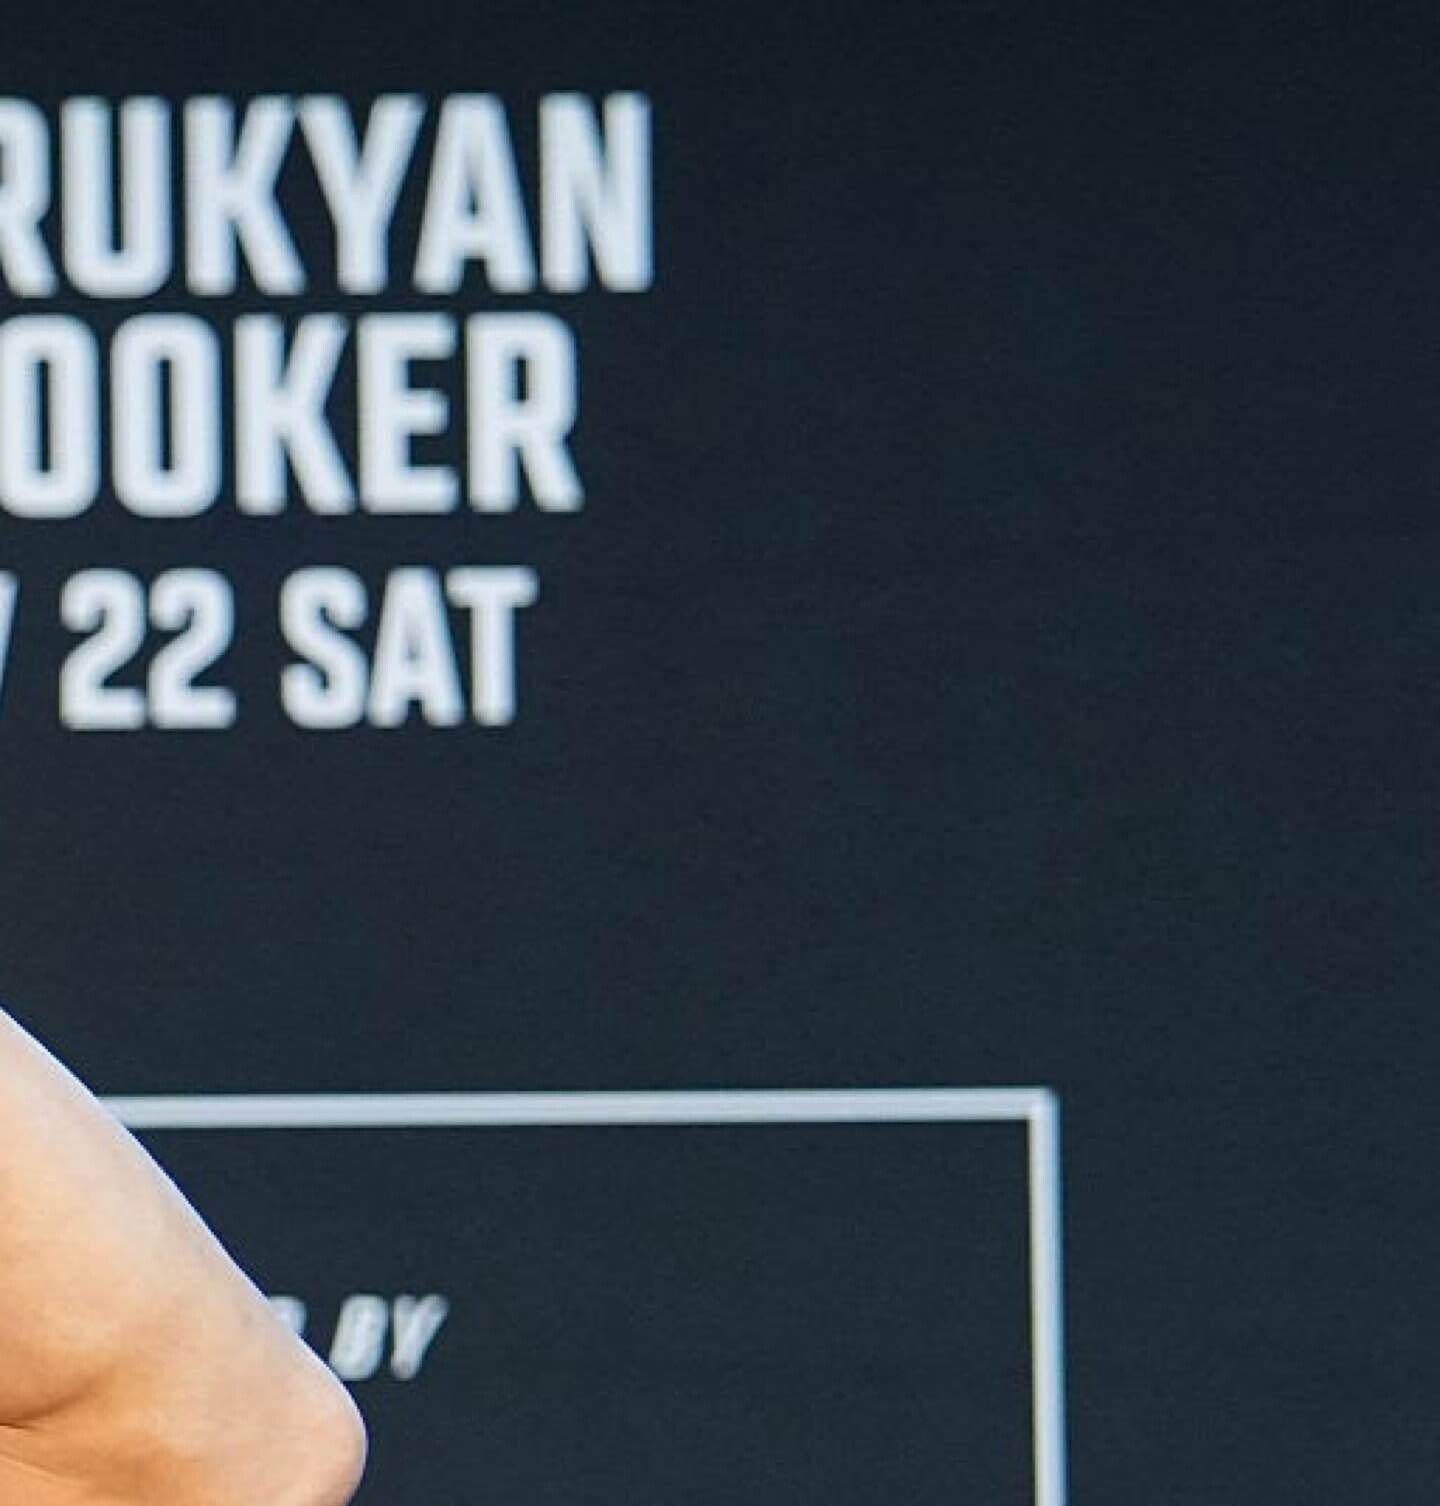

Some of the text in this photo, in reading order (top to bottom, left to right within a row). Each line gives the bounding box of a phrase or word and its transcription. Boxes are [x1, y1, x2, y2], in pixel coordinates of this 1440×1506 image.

[59, 568, 237, 729] 22
[280, 566, 538, 728] SAT
[328, 1295, 448, 1380] BY
